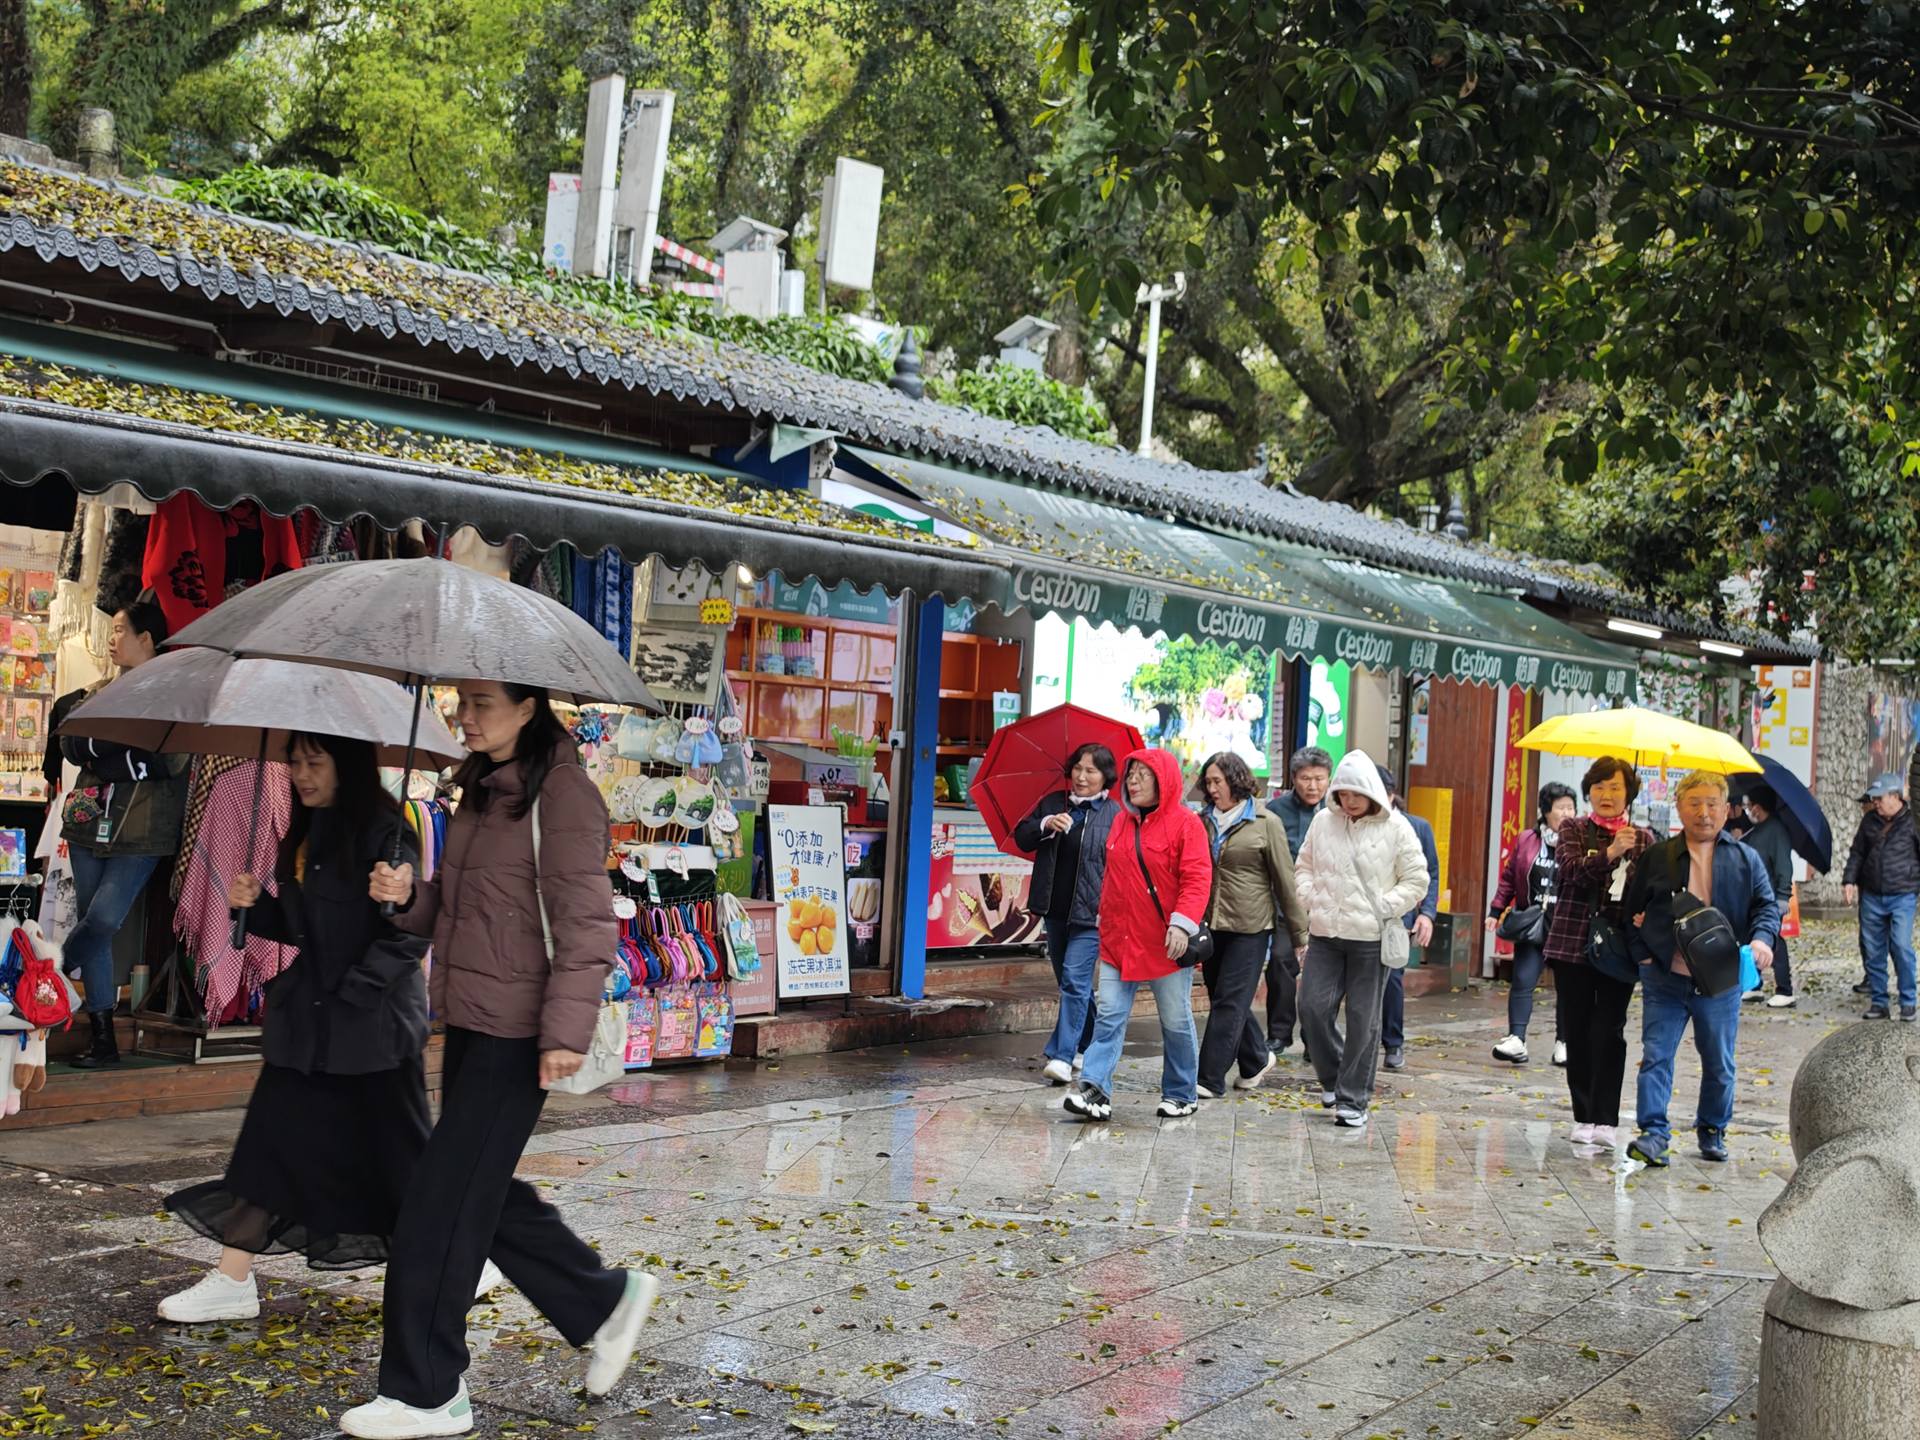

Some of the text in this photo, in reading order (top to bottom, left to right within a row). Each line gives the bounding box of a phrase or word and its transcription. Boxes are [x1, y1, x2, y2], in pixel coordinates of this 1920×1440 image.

[1014, 566, 1100, 613] C'estbon
[1197, 601, 1266, 642] C'estbon
[1335, 627, 1393, 664] C'estbon
[1451, 647, 1502, 679] C'estbon
[819, 767, 841, 785] HOT
